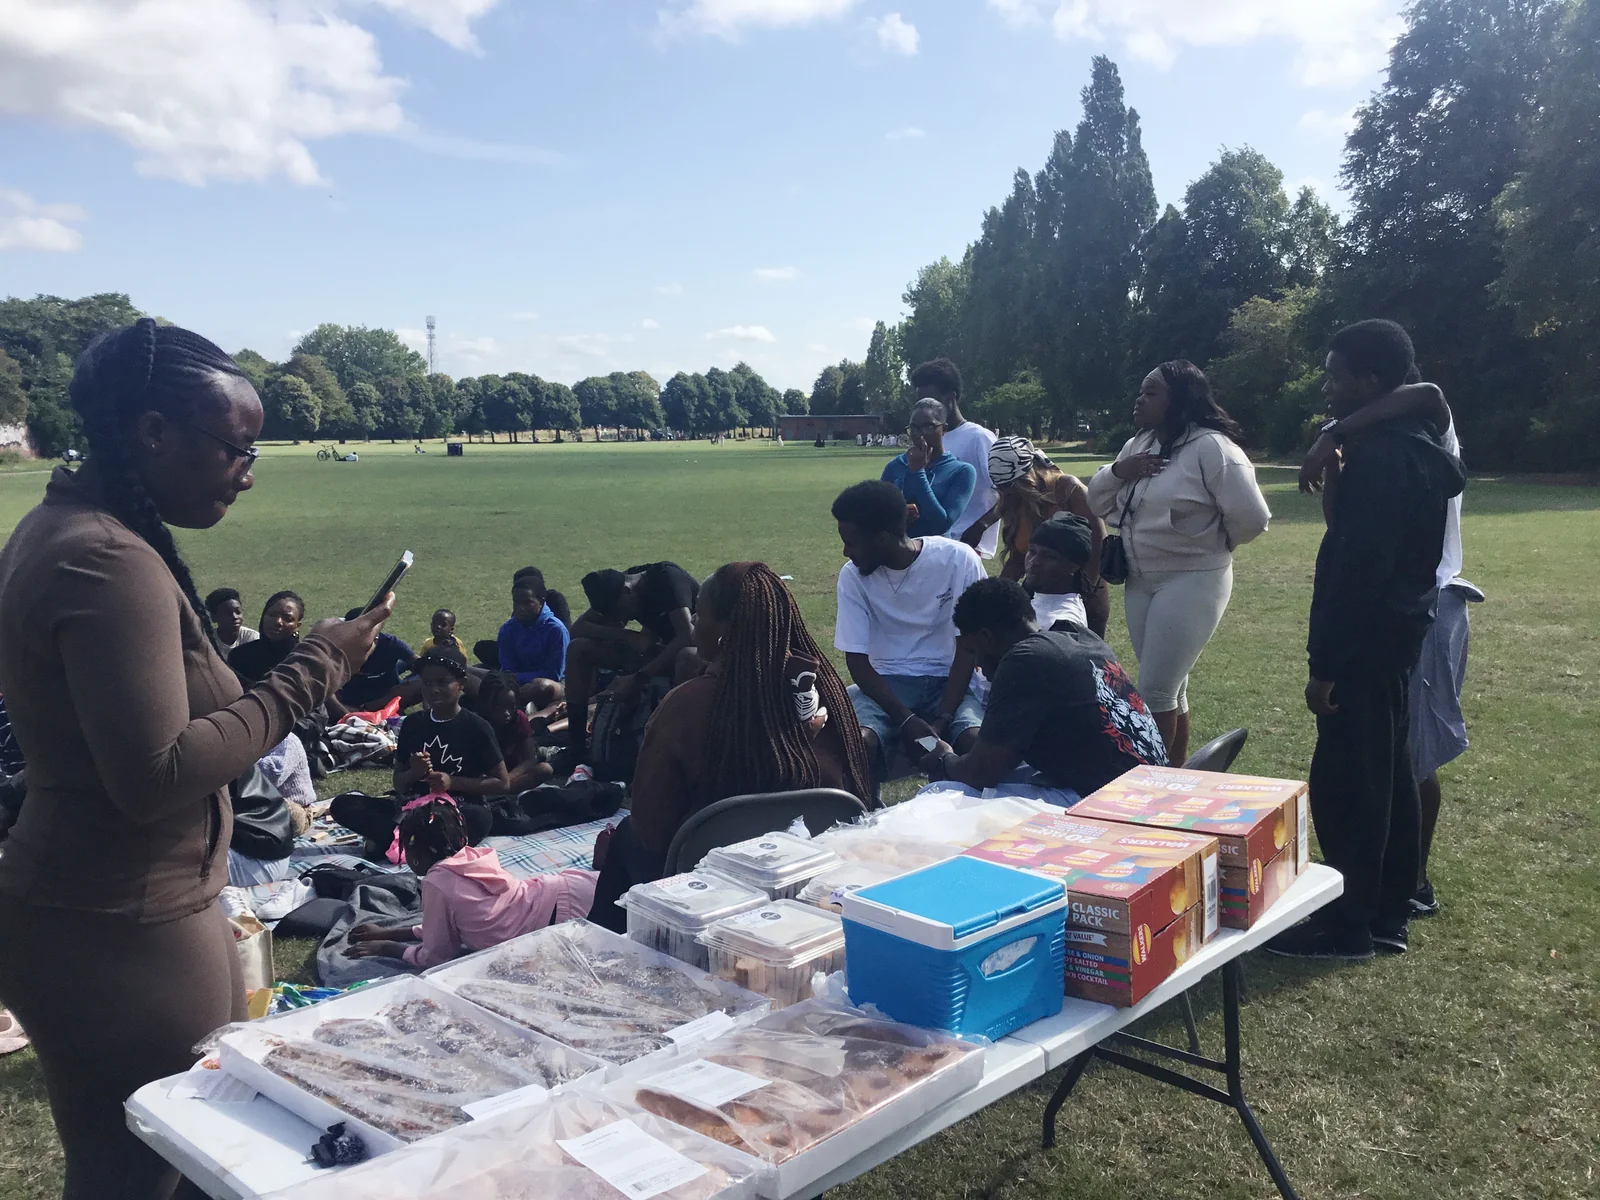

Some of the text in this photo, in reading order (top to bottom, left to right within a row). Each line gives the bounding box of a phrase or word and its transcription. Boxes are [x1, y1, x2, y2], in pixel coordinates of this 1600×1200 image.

[1216, 784, 1283, 792] WALKERS
[1065, 834, 1098, 844] 20
[1119, 838, 1190, 848] WALKERS
[1071, 902, 1120, 920] CLASSIC
[1072, 913, 1104, 927] PACK
[1137, 924, 1147, 963] WALKERS
[1074, 957, 1099, 968] SALTED
[1082, 952, 1105, 962] ONION
[1075, 965, 1105, 977] VINEGAR
[1077, 973, 1109, 985] COCKTAIL
